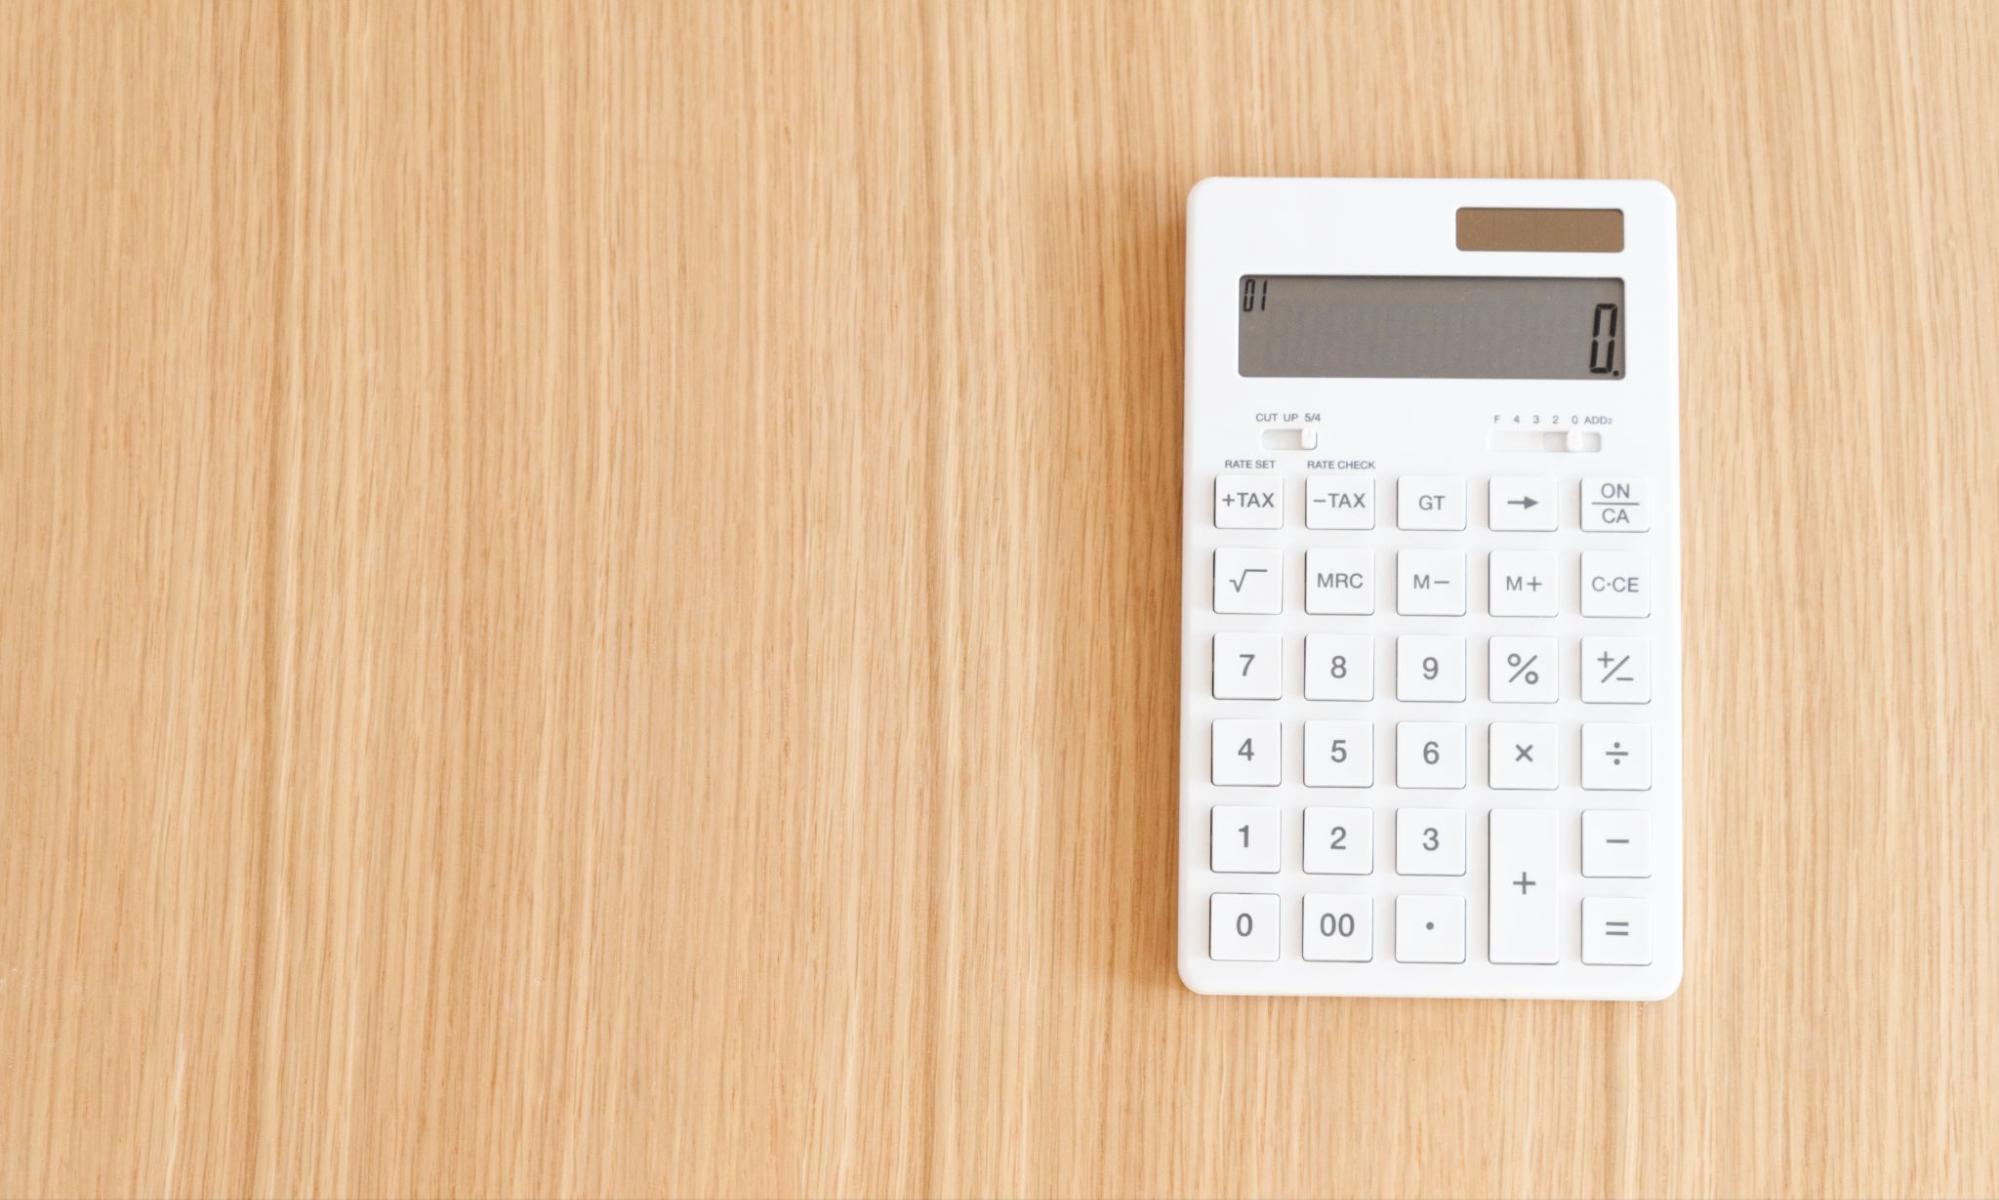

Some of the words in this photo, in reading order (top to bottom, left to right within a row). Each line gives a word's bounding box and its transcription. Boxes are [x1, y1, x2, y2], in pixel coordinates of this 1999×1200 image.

[1255, 412, 1279, 423] CUT
[1282, 412, 1300, 423] UP
[1303, 412, 1322, 423] 5/4
[1493, 414, 1501, 424] F
[1512, 414, 1521, 425] 4
[1532, 414, 1541, 425] 3
[1551, 414, 1560, 425] 2
[1570, 414, 1580, 426] 0
[1224, 459, 1252, 470] RATE
[1254, 459, 1276, 470] SET
[1306, 459, 1335, 470] RATE
[1337, 459, 1376, 471] CHECK
[1221, 491, 1275, 509] +TAX
[1600, 482, 1630, 499] ON
[1418, 494, 1446, 512] GT
[1601, 507, 1630, 524] CA
[1316, 572, 1364, 590] MRC
[1505, 575, 1543, 593] M+
[1239, 653, 1256, 677] 7
[1330, 655, 1348, 680] 8
[1422, 656, 1440, 681] 9
[1506, 652, 1540, 686] %
[1237, 737, 1256, 762] 4
[1330, 739, 1348, 764] 5
[1422, 740, 1441, 766] 6
[1237, 824, 1250, 849] 1
[1329, 825, 1347, 851] 2
[1422, 826, 1440, 852] 3
[1235, 912, 1254, 938] 0
[1319, 912, 1356, 938] 00
